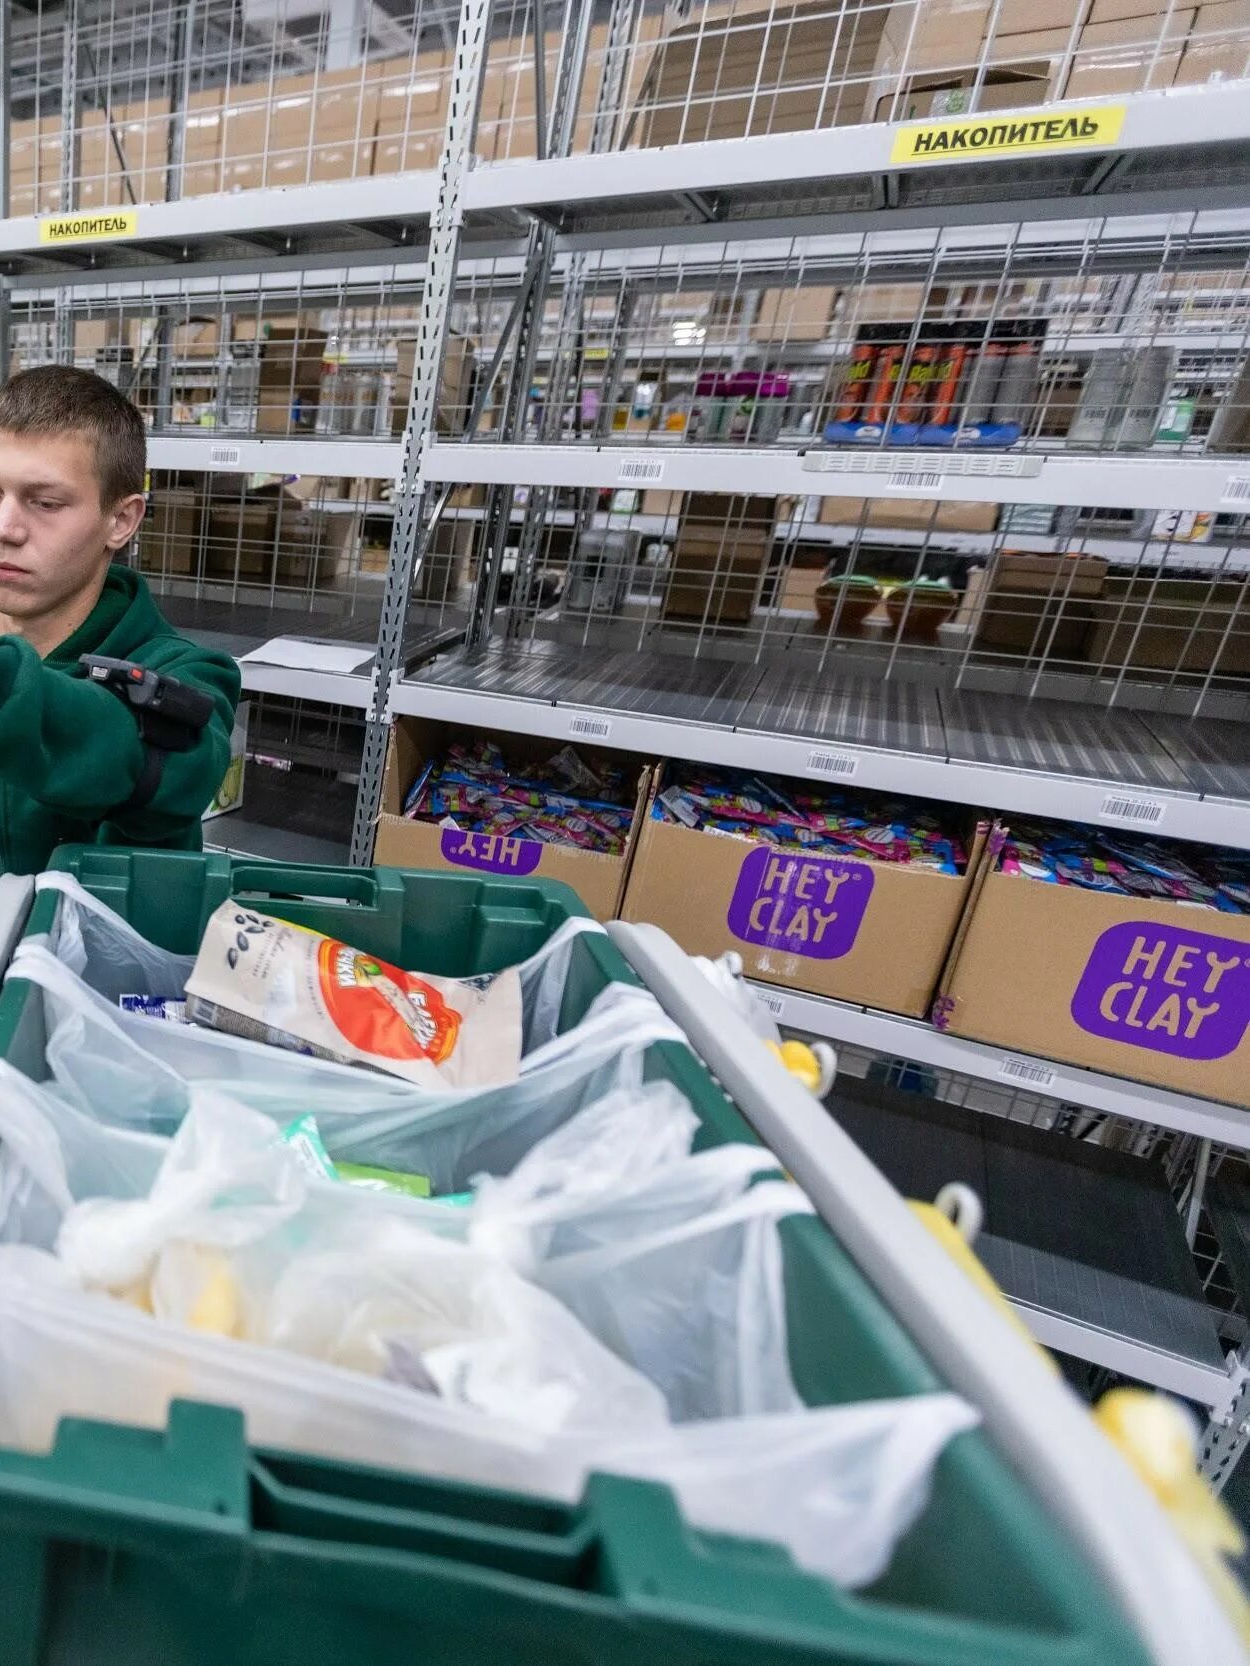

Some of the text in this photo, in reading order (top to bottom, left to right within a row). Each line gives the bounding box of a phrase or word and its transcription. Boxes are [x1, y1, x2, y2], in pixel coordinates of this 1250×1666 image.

[913, 116, 1099, 153] НАКОПИТЕЛЬ
[49, 217, 127, 236] НАКОПИТЕЛЬ
[763, 857, 850, 905] HEY
[749, 896, 839, 944] CLAY
[1121, 935, 1241, 994] HEY
[1099, 981, 1221, 1040] CLAY
